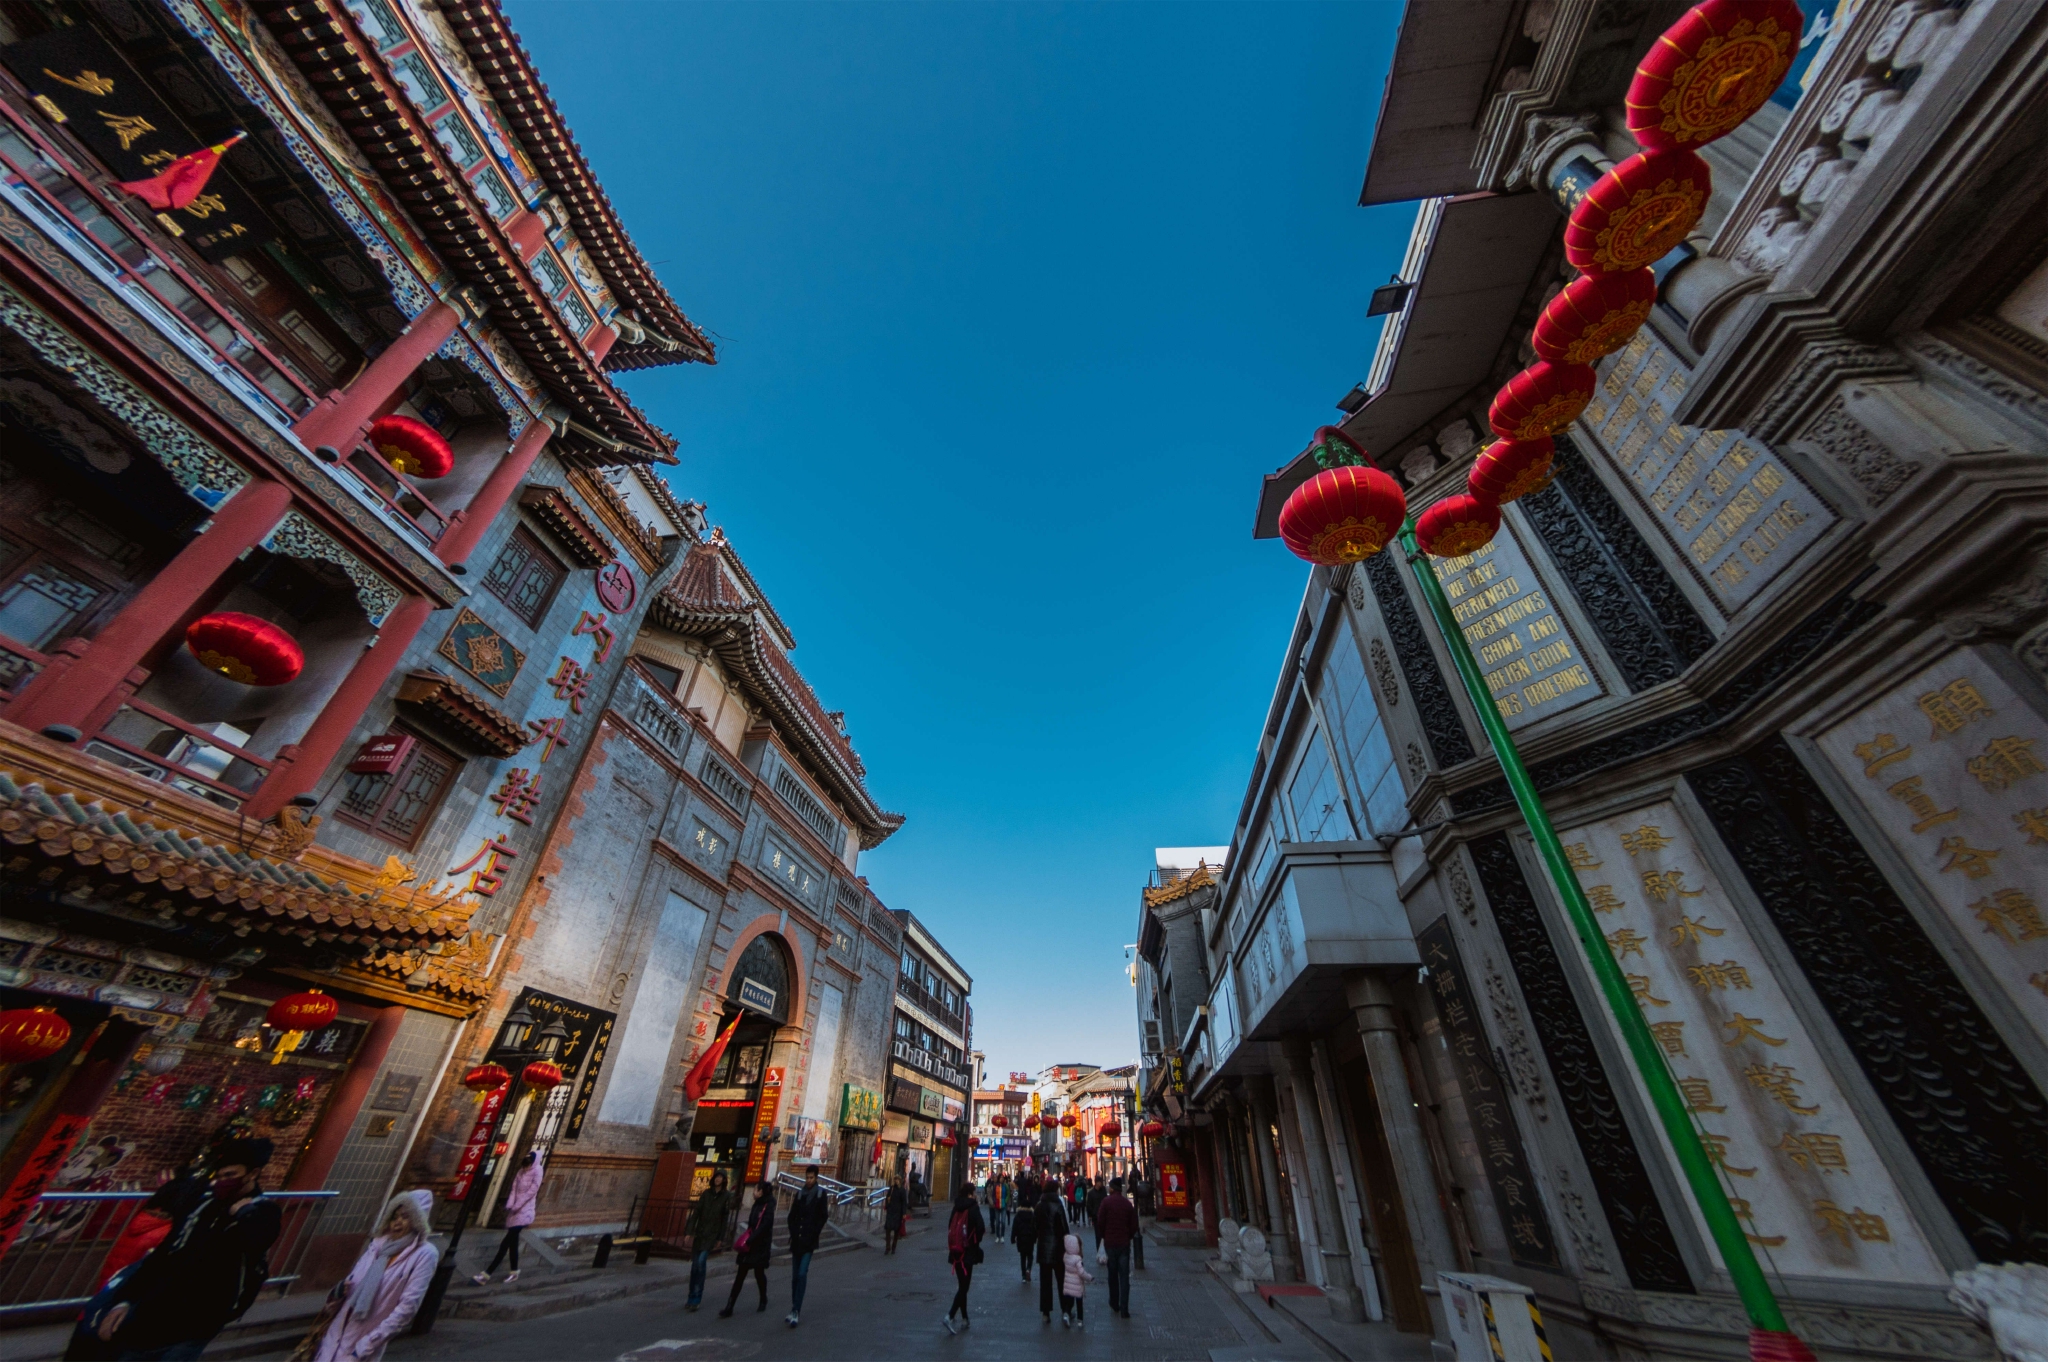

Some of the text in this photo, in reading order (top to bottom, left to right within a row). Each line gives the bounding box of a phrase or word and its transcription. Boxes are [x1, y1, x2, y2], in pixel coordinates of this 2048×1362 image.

[1646, 399, 1667, 424] OF
[1661, 367, 1686, 402] THE
[1752, 462, 1785, 499] AND
[1446, 559, 1500, 599] WE HAVE
[1710, 552, 1750, 595] FINE
[1451, 576, 1520, 624] XPERIENCED
[1462, 591, 1547, 647] PRESENTATIVES
[1480, 632, 1523, 665] CHINA
[1528, 614, 1559, 642] AND
[1482, 657, 1532, 695] OREIGN
[1530, 639, 1571, 672] COUN-
[1495, 664, 1590, 719] RIES ORDERING
[447, 609, 616, 896] 内联升鞋店
[1009, 1071, 1027, 1083] 客房
[1052, 1067, 1079, 1081] 宾馆
